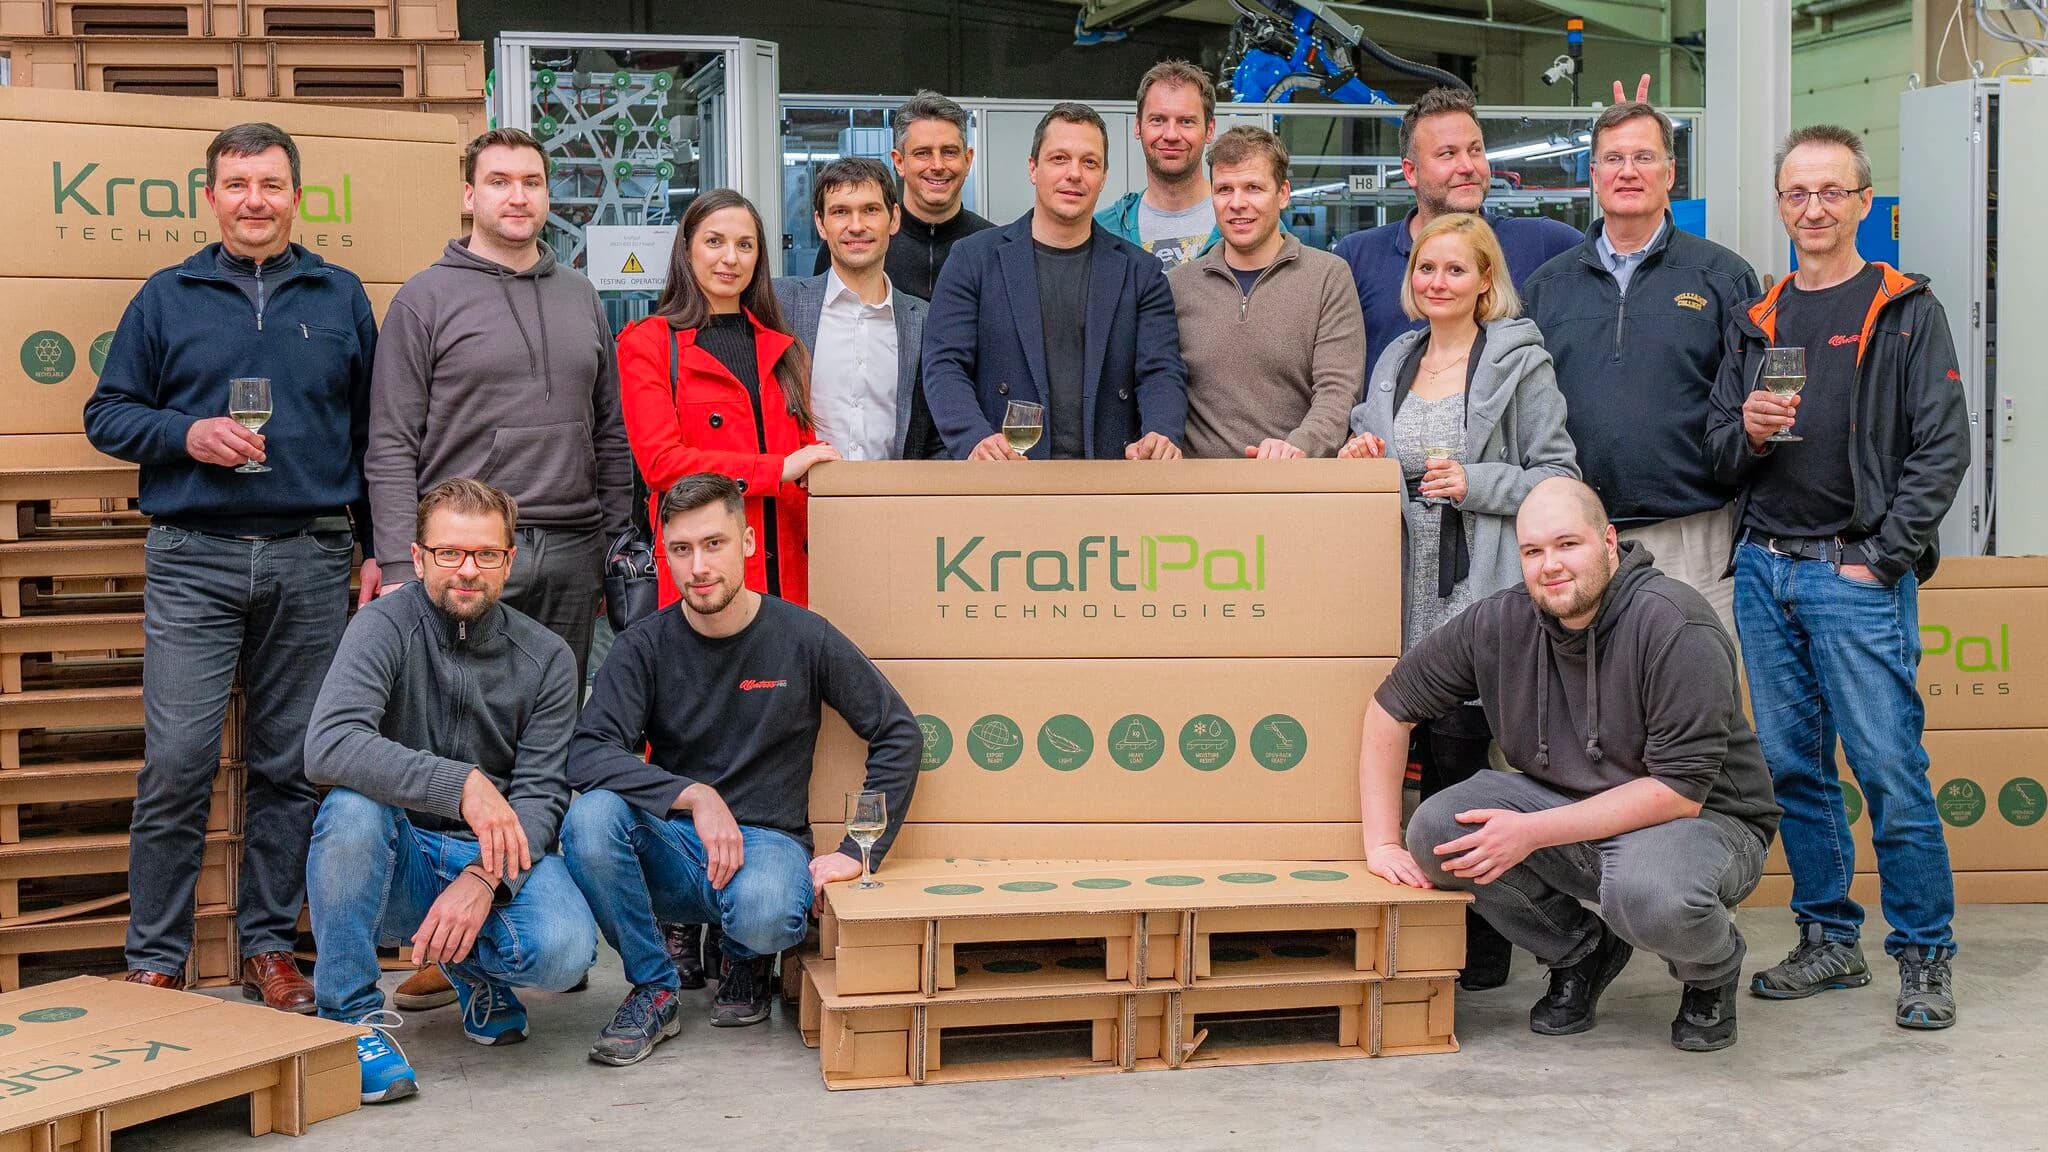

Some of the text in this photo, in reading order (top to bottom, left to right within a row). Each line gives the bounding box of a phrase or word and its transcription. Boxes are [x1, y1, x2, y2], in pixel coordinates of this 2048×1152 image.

[53, 160, 352, 225] Krafal
[1355, 177, 1373, 190] H8
[55, 226, 353, 248] TECHNOIES
[936, 534, 1265, 592] KraftPal
[937, 603, 1266, 618] TECHNOLOGIES
[0, 1040, 193, 1099] Kraf
